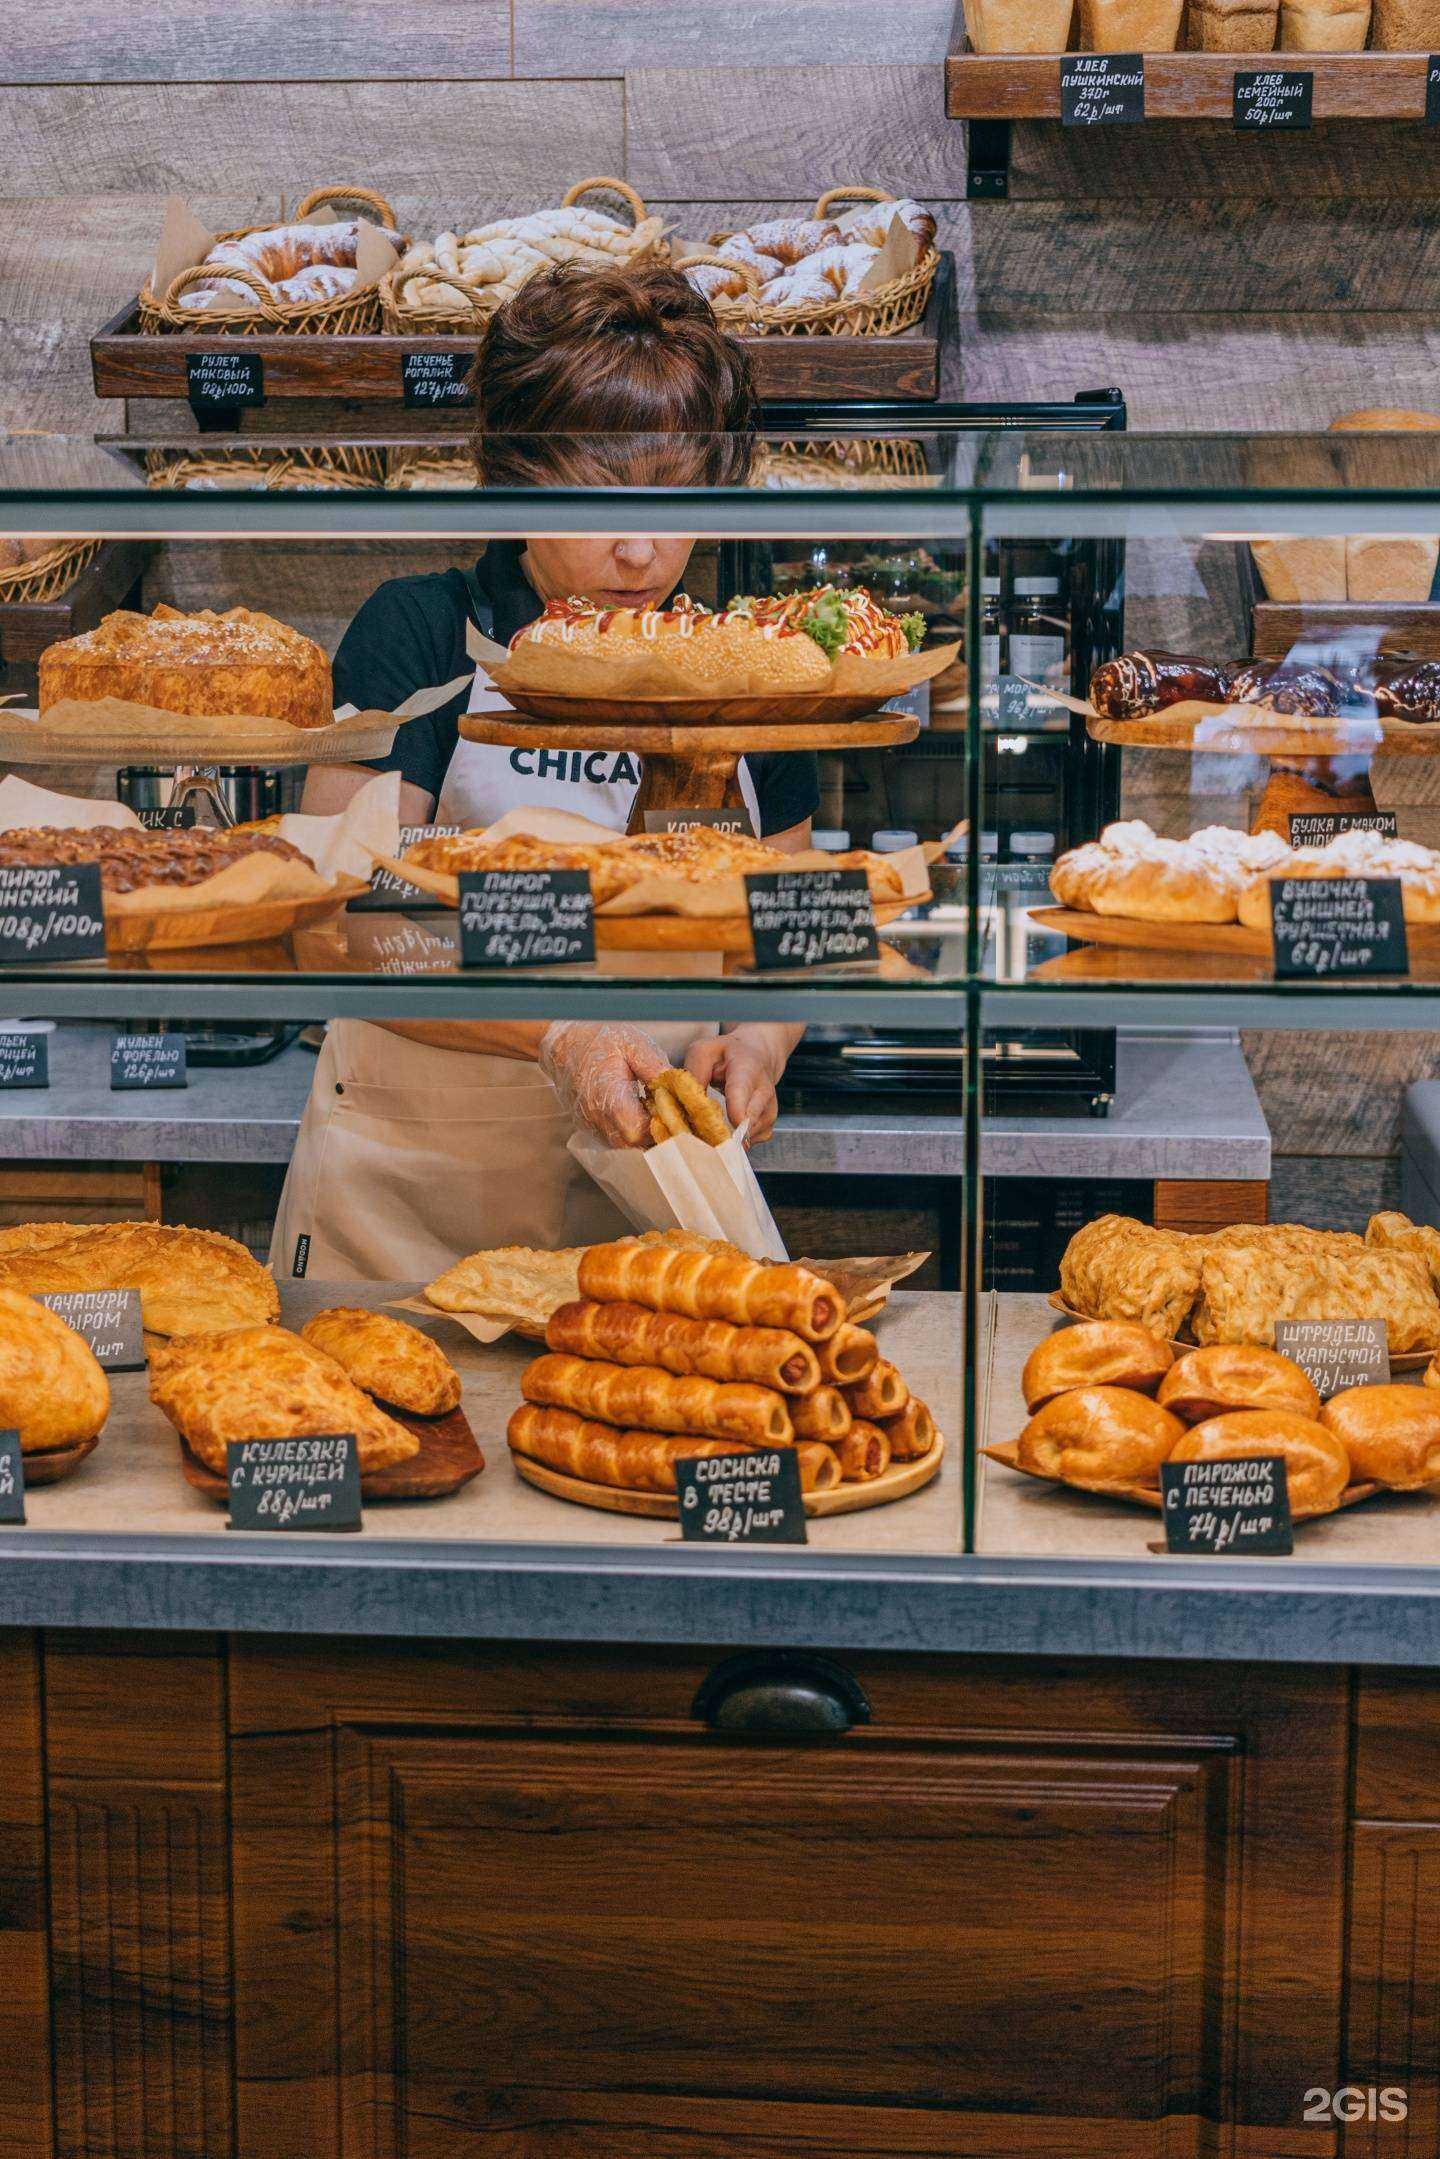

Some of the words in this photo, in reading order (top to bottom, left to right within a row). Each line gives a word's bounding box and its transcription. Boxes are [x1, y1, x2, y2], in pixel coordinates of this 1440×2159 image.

[1074, 59, 1109, 73] ХЛЕБ
[1061, 70, 1143, 88] ПУШКИНСКИЙ
[1253, 74, 1283, 86] ХЛЕБ
[1078, 87, 1110, 100] 370г
[1237, 82, 1304, 99] СЕМЕЙНЫЙ
[1255, 96, 1284, 108] 200г
[201, 355, 240, 368] РУЛЕТ
[408, 354, 455, 367] ПЕЧЕНЬЕ
[189, 366, 251, 381] МАКОВЫЙ
[404, 367, 453, 378] РОГАЛИК
[509, 747, 641, 785] CHICA
[1291, 817, 1334, 835] БУЛКА
[1340, 818, 1348, 833] С
[1351, 816, 1395, 832] МАКОМ
[483, 872, 552, 892] ПИРОГ
[1282, 879, 1368, 901] БУЛОЧКА
[1274, 901, 1288, 921] С
[1292, 898, 1374, 920] ВИШНЕЙ
[1274, 920, 1390, 941] ФУРШЕТНАЯ
[116, 1036, 163, 1050] ЖУЛЬЕН
[111, 1051, 120, 1063] С
[122, 1050, 180, 1063] ФОРЕЛЬЮ
[43, 1291, 129, 1311] ХАЧАПУРИ
[1283, 1325, 1376, 1346] ШТРУДЕЛЬ
[1295, 1345, 1382, 1364] КАПУСТОЙ
[241, 1439, 349, 1463] КУЛЕБЯКА
[231, 1466, 246, 1488] С
[251, 1459, 345, 1486] КУРИЦЕЙ
[695, 1454, 781, 1482] СОСИСКА
[1183, 1461, 1274, 1485] ПИРОЖОК
[683, 1485, 699, 1509] В
[708, 1480, 772, 1505] ТЕСТЕ
[1166, 1487, 1180, 1510] С
[1184, 1484, 1275, 1507] ПЕЧЕНЬЮ
